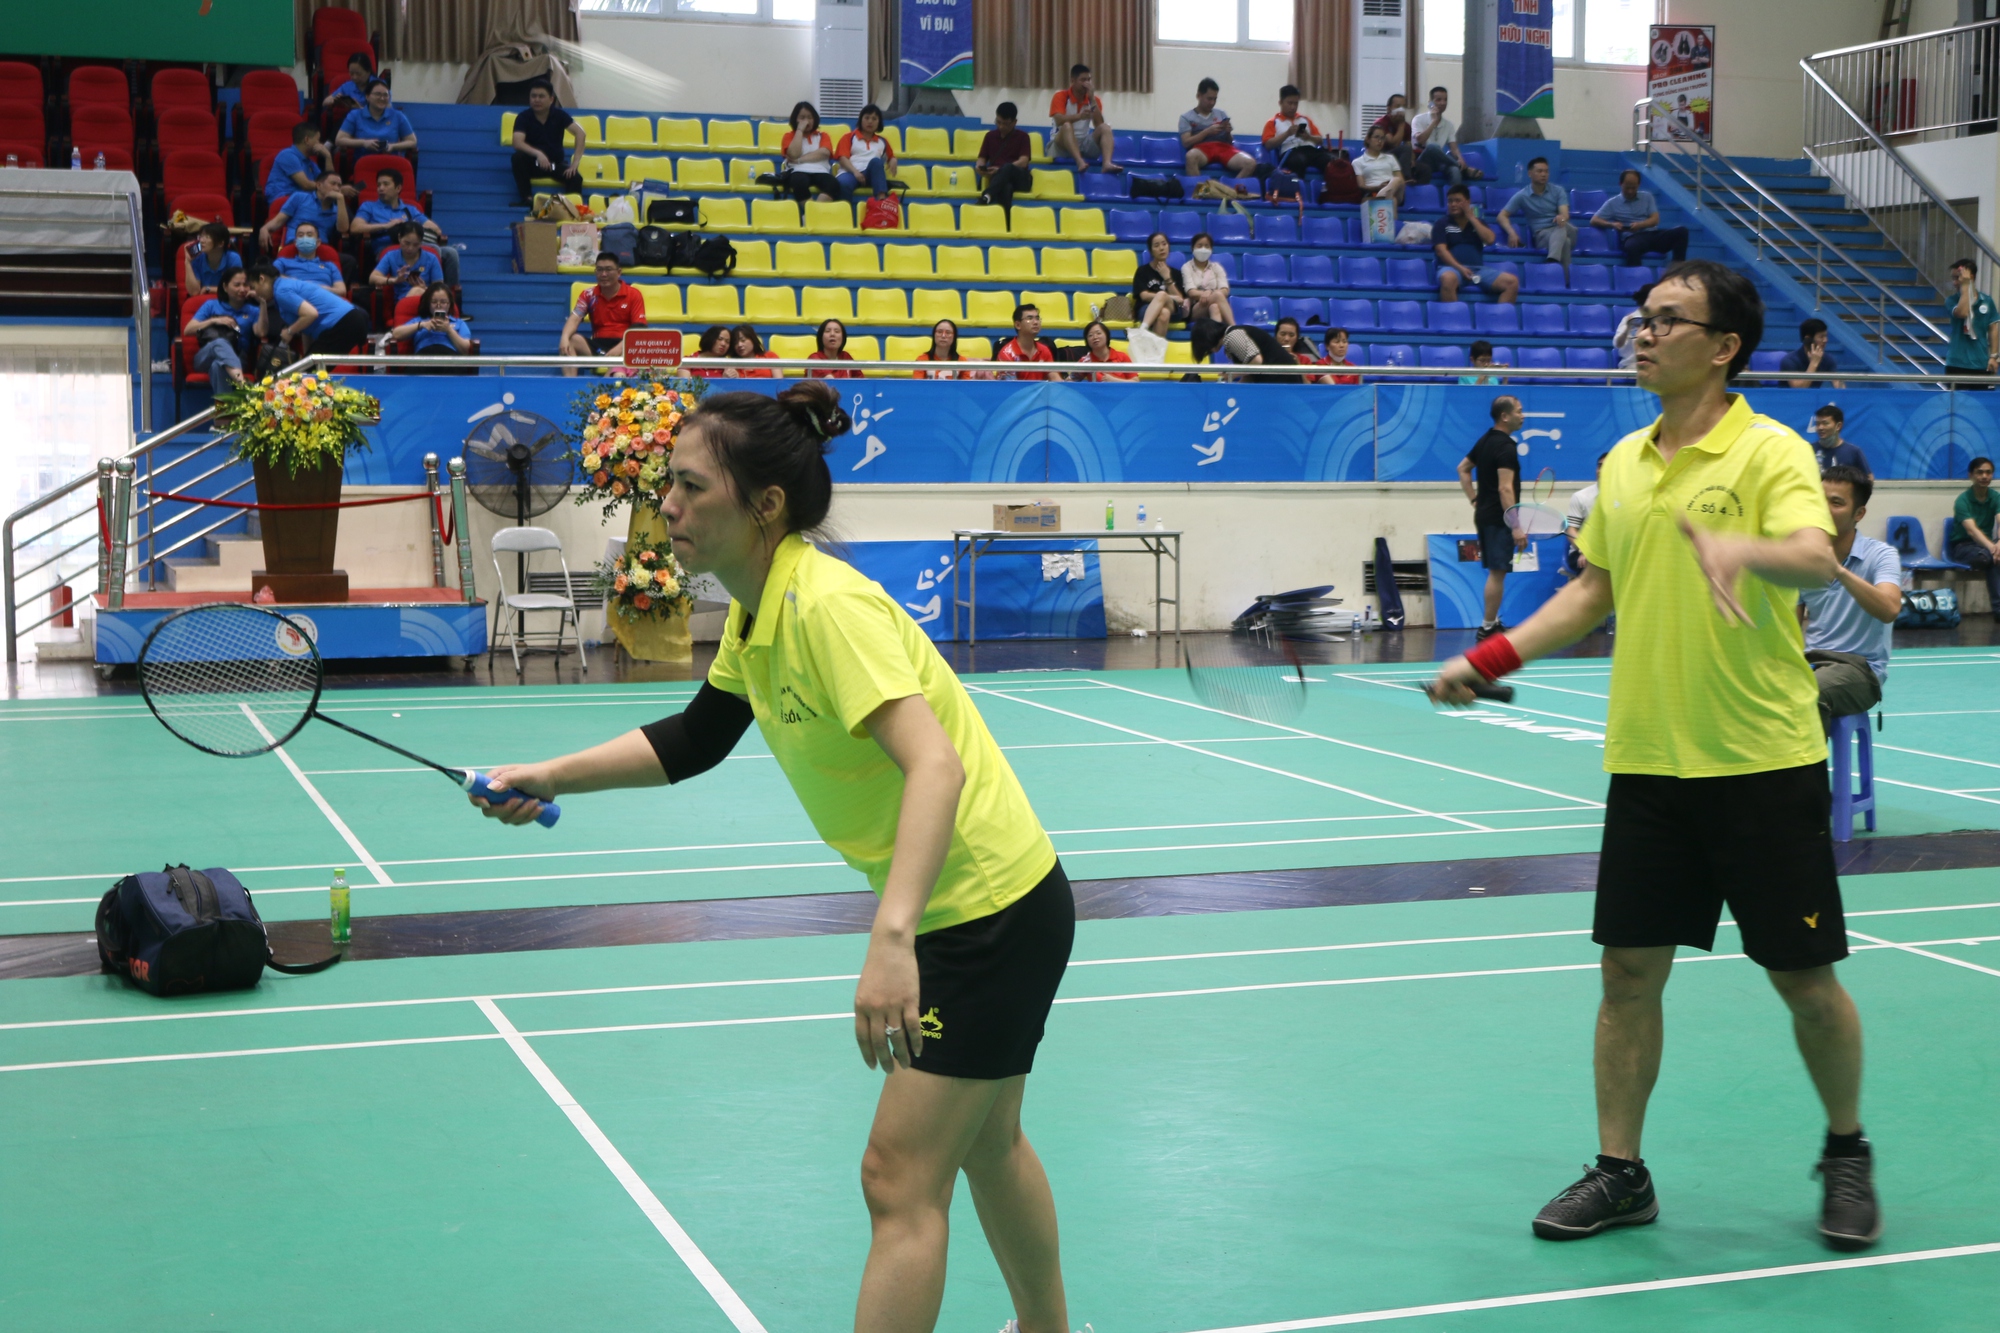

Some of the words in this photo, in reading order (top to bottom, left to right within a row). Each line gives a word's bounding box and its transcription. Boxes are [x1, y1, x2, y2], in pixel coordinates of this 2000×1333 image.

[920, 14, 932, 31] VĨ
[934, 17, 954, 35] ĐẠI
[1499, 23, 1523, 44] HỮU
[1524, 27, 1551, 50] NGHỊ
[1652, 80, 1668, 90] PRO
[1669, 72, 1707, 86] CLEANING
[638, 346, 647, 354] ÁN
[631, 356, 650, 365] chúc
[650, 357, 674, 366] mừng
[1719, 506, 1727, 515] 4
